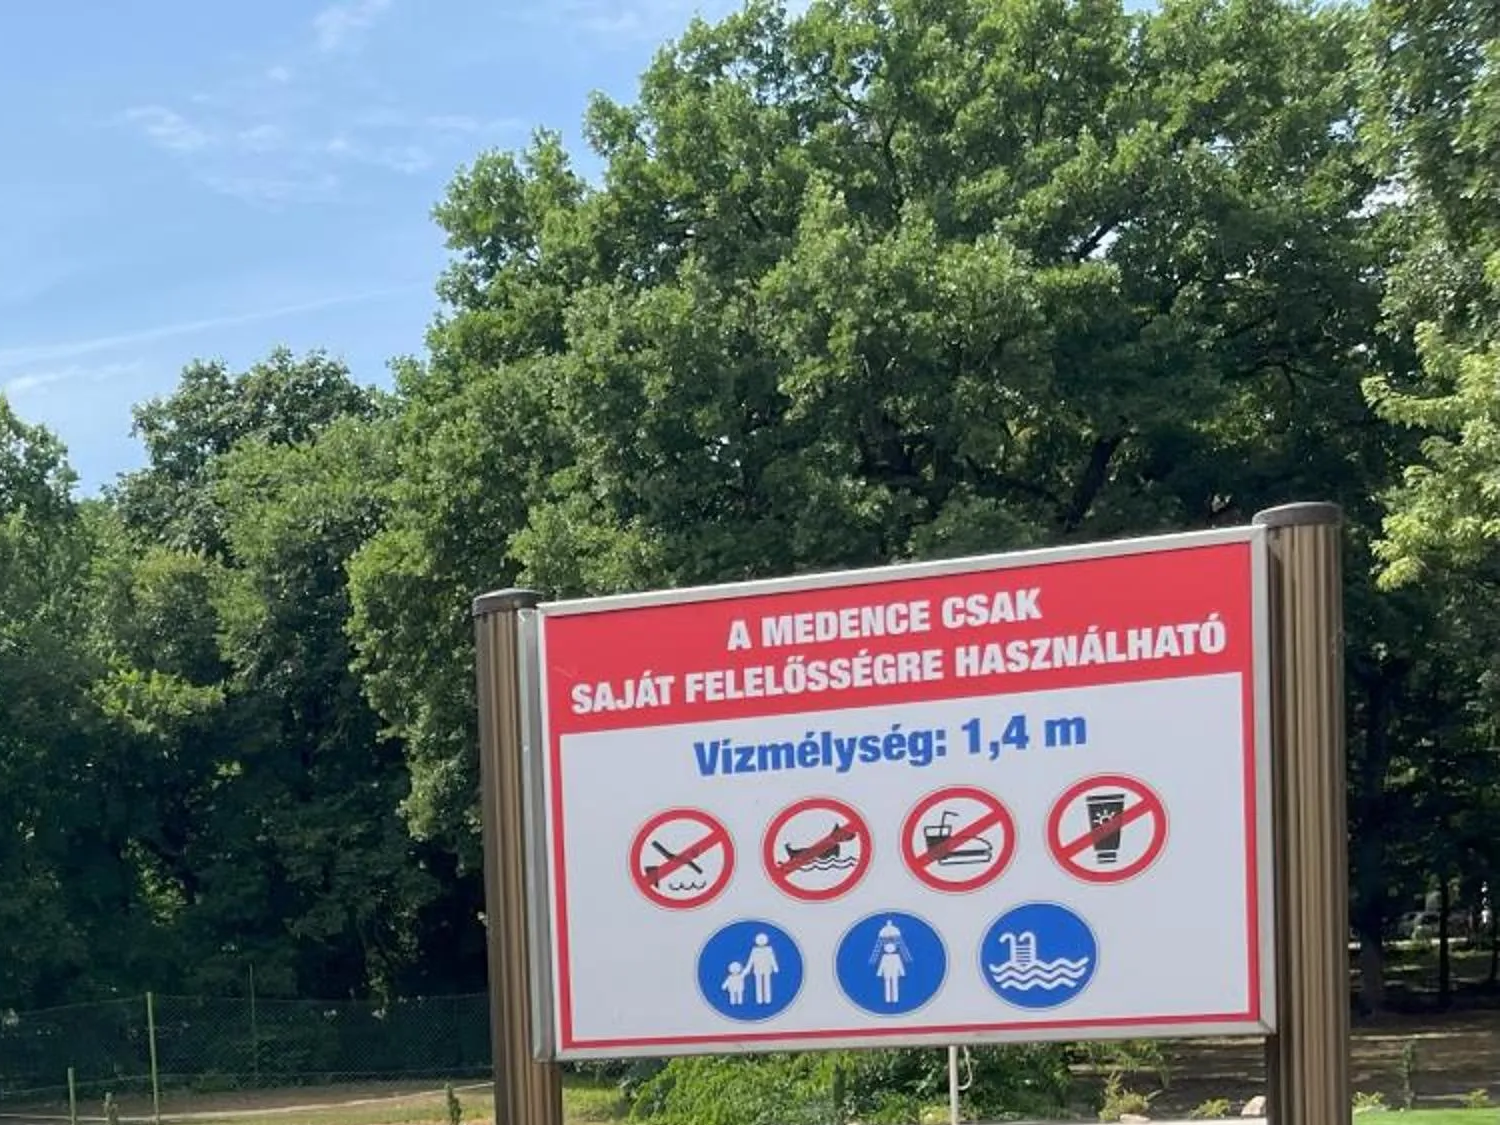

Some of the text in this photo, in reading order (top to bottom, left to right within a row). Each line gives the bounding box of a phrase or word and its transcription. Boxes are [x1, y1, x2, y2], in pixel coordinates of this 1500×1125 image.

[726, 588, 1044, 650] A MEDENCE CSAK
[570, 613, 1227, 714] SAJÁT FELELŐSSÉGRE HASZNÁLHATÓ
[693, 715, 1087, 776] Vízmélység: 1,4 m
